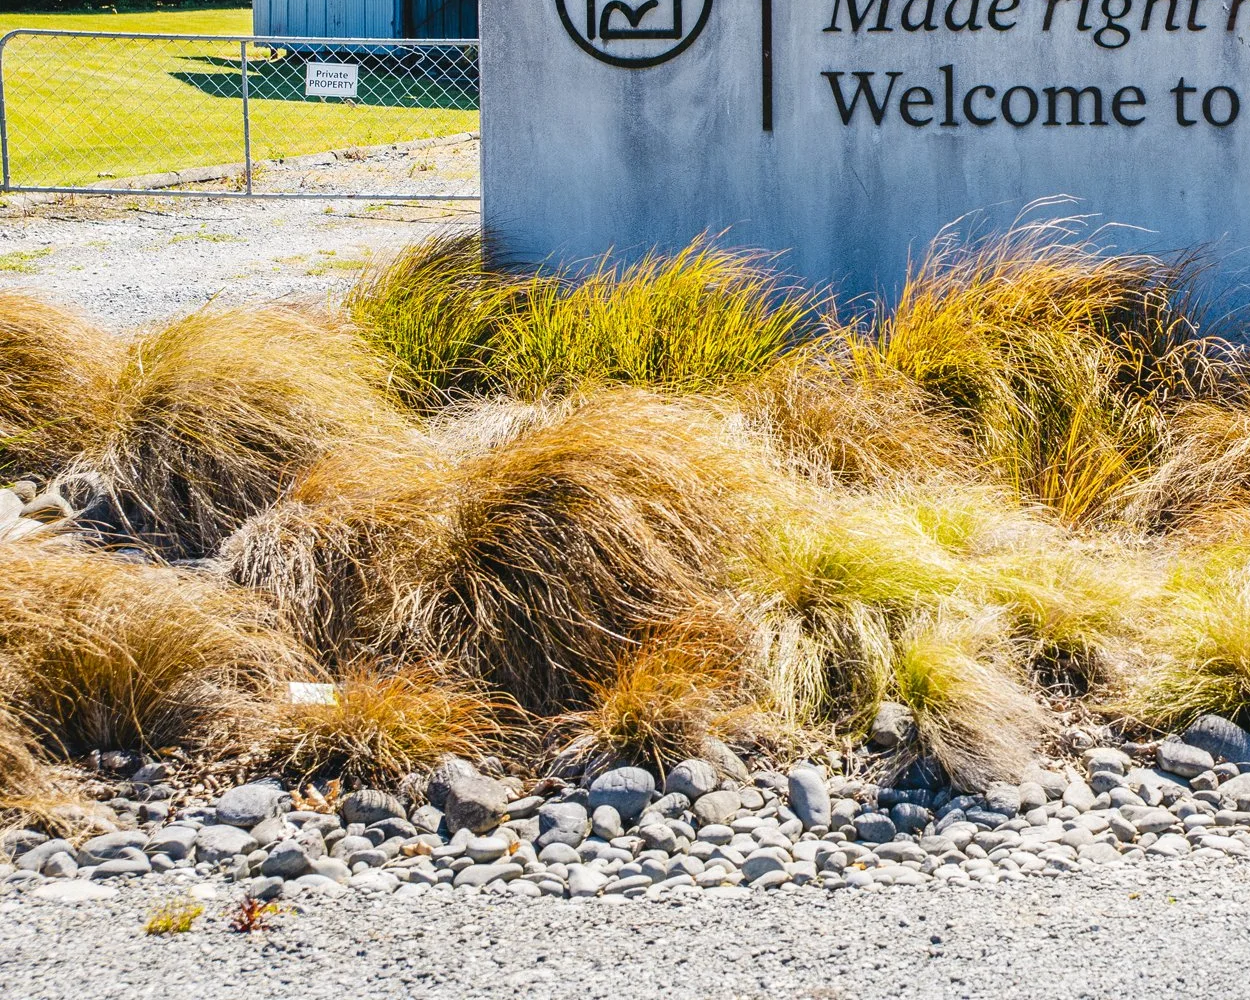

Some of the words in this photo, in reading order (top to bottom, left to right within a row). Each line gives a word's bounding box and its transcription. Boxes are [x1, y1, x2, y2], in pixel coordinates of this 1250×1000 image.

[316, 69, 349, 79] Private
[309, 79, 354, 89] PROPERTY
[821, 65, 1148, 129] Welcome
[1170, 77, 1242, 129] to
